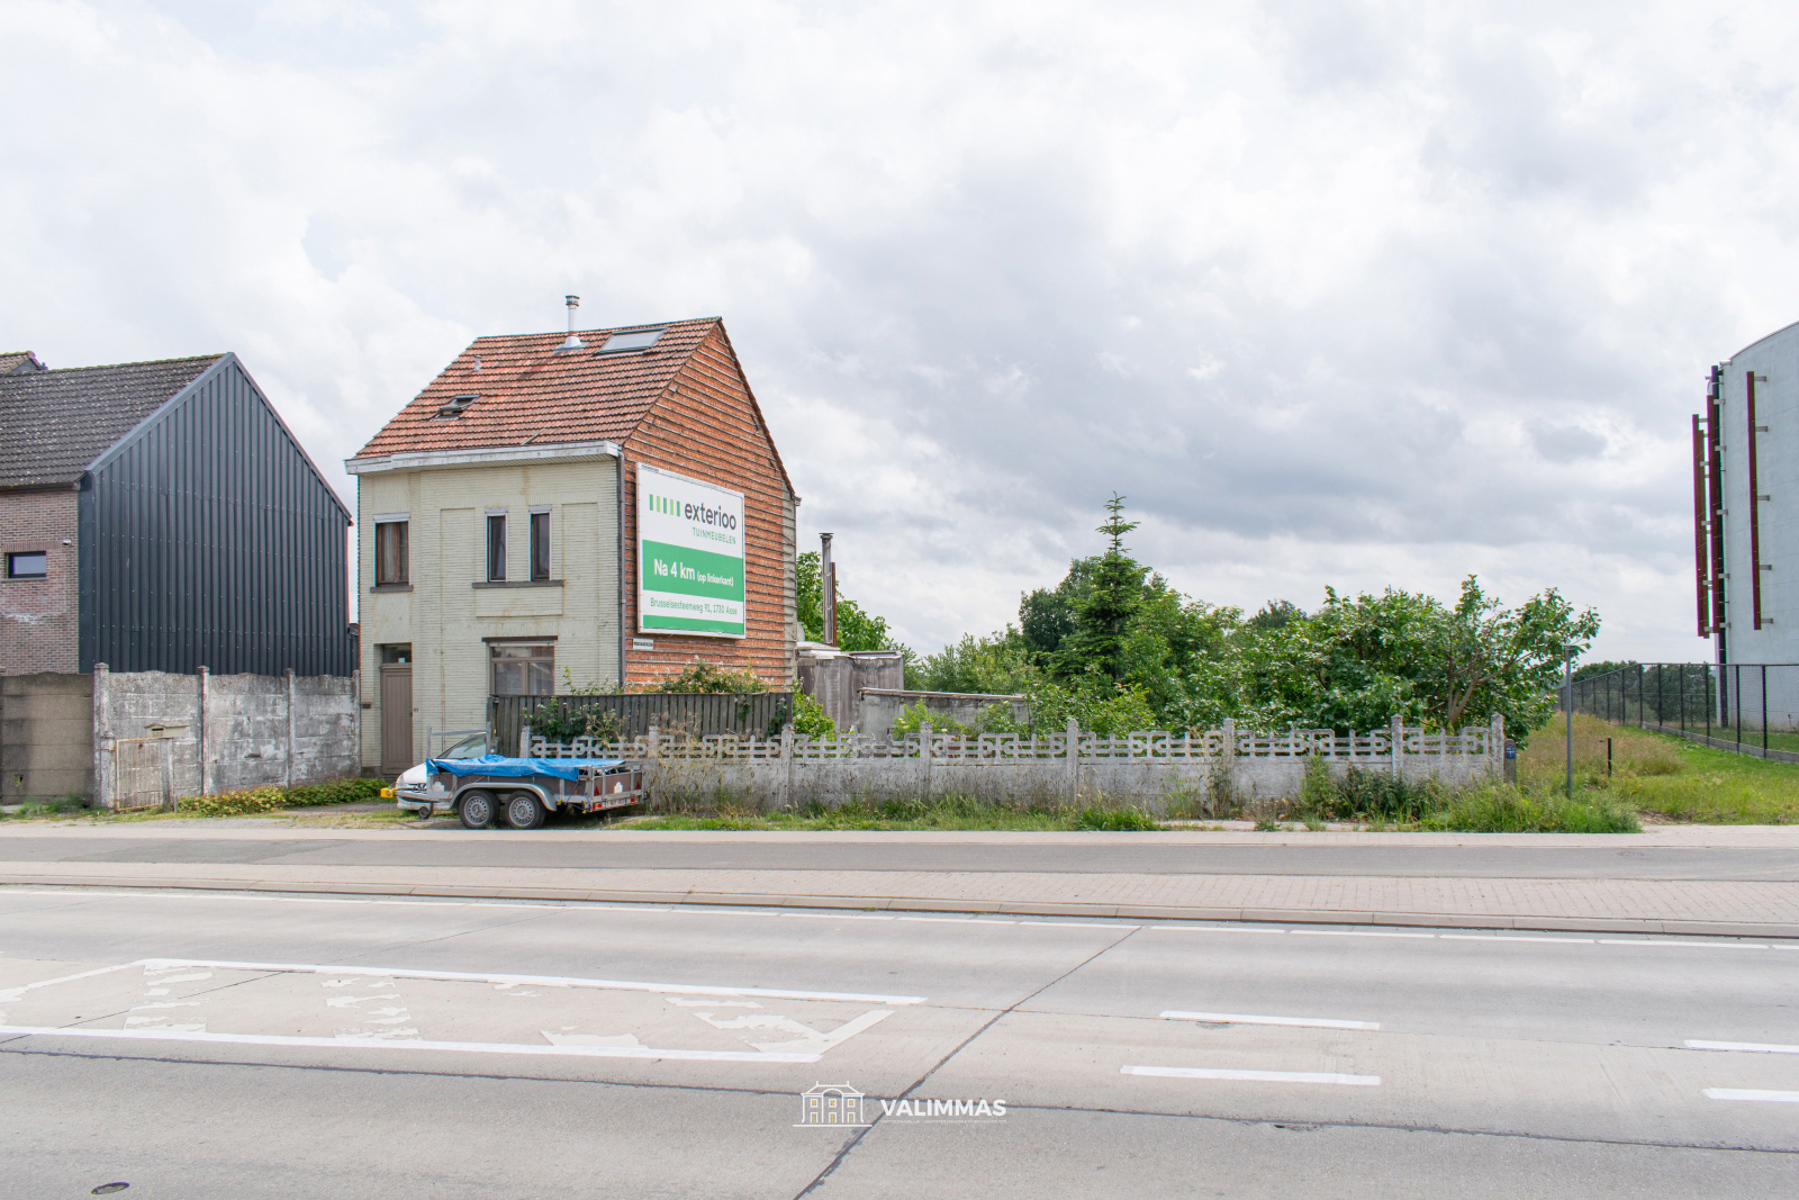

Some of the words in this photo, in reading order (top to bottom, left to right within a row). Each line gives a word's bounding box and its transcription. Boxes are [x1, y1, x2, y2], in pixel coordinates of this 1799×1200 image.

[684, 503, 737, 530] exterioo
[692, 527, 737, 545] TUINMEUBELEN
[654, 558, 668, 577] Na
[670, 561, 678, 578] 4
[680, 562, 695, 581] km
[697, 570, 707, 584] (op
[707, 573, 734, 587] linkerkant)
[650, 598, 703, 614] Brusselsesteenweg
[726, 606, 738, 616] Asse
